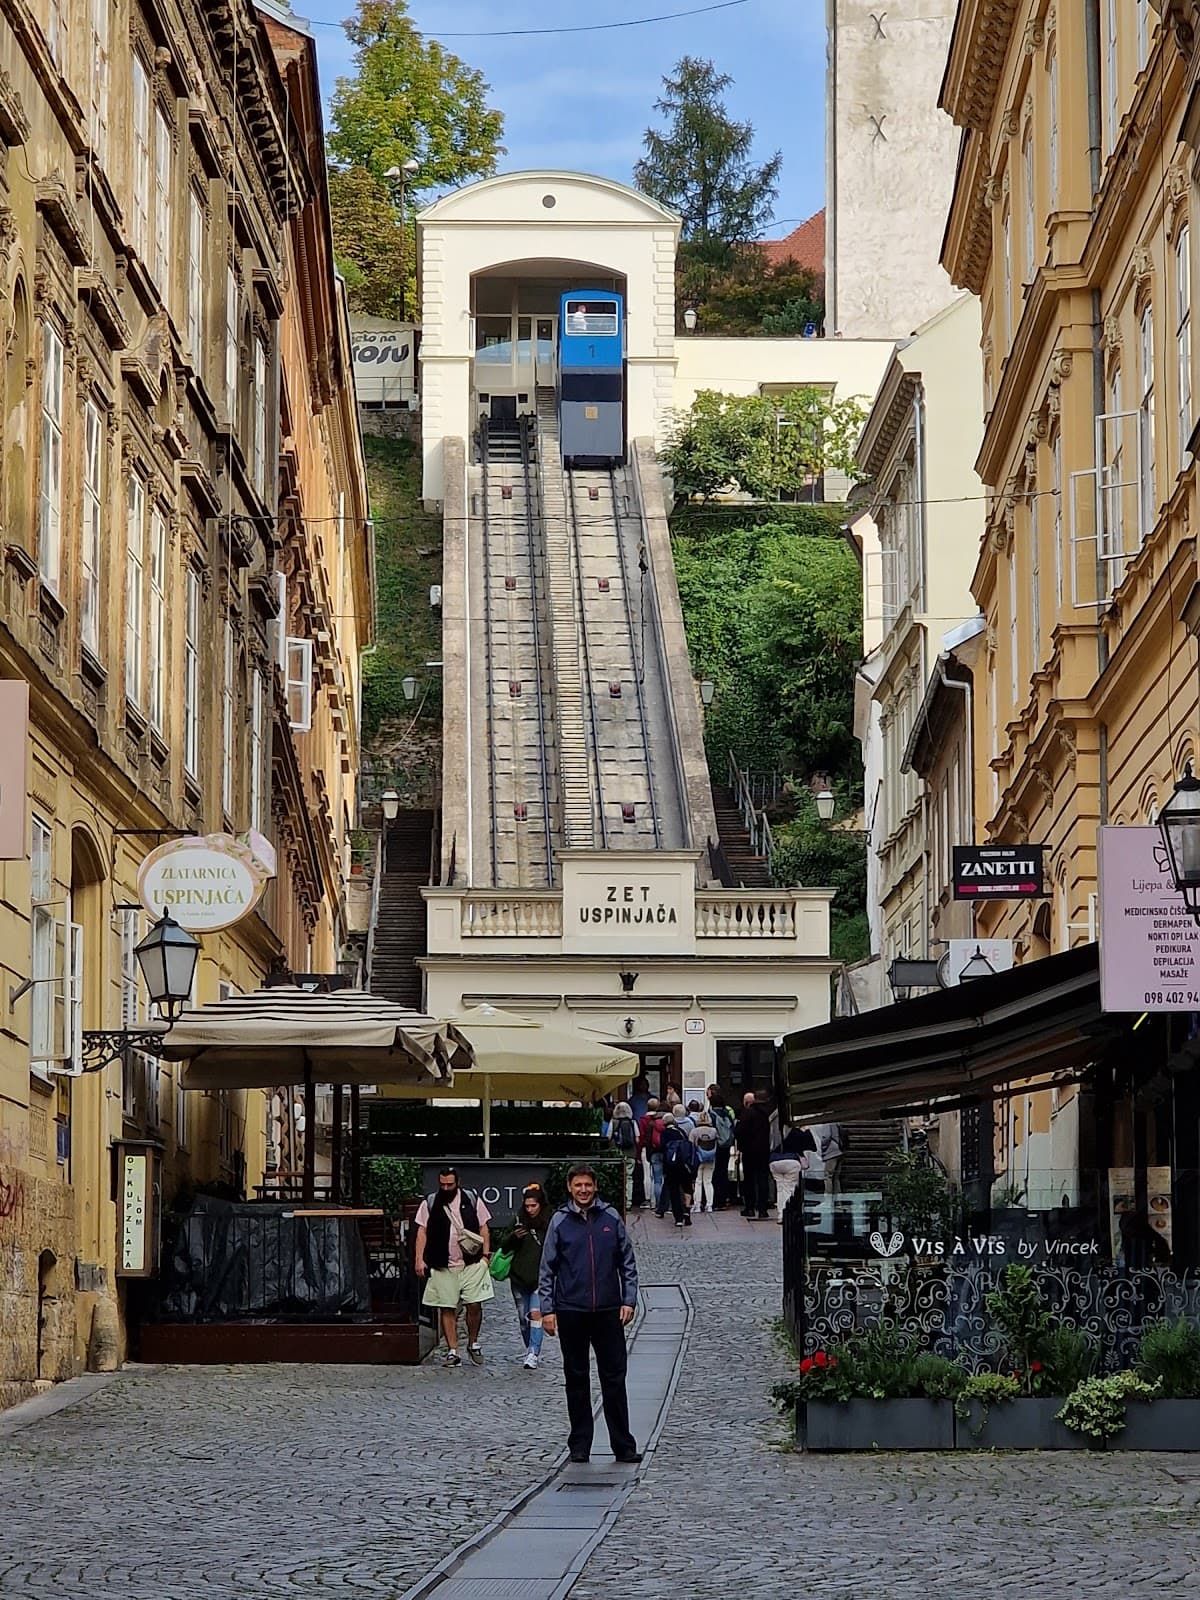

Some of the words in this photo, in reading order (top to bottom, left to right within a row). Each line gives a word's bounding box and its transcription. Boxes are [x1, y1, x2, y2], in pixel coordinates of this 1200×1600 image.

[379, 335, 396, 343] na
[588, 344, 595, 358] 1
[161, 867, 237, 880] ZLATARNICA
[960, 861, 1035, 876] ZANETTI
[1132, 879, 1163, 894] Lijepa
[153, 885, 245, 906] USPINJAČA
[607, 886, 650, 903] ZET
[580, 904, 677, 923] USPINJAČA
[1124, 907, 1168, 916] MEDICINSKO
[1153, 919, 1193, 929] DERMAPEN
[1147, 932, 1169, 941] NOKTI
[1171, 932, 1183, 941] OPI
[1185, 932, 1199, 941] LAK
[1155, 945, 1192, 954] PEDIKURA
[1153, 957, 1195, 966] DEPILACIJA
[1160, 968, 1189, 978] MASAŽE
[1144, 991, 1163, 1004] 098
[1166, 991, 1184, 1004] 402
[1187, 991, 1200, 1004] 94
[135, 1195, 143, 1226] LOM
[953, 1235, 966, 1255] À
[1017, 1239, 1037, 1259] by
[1044, 1238, 1099, 1256] Vincek
